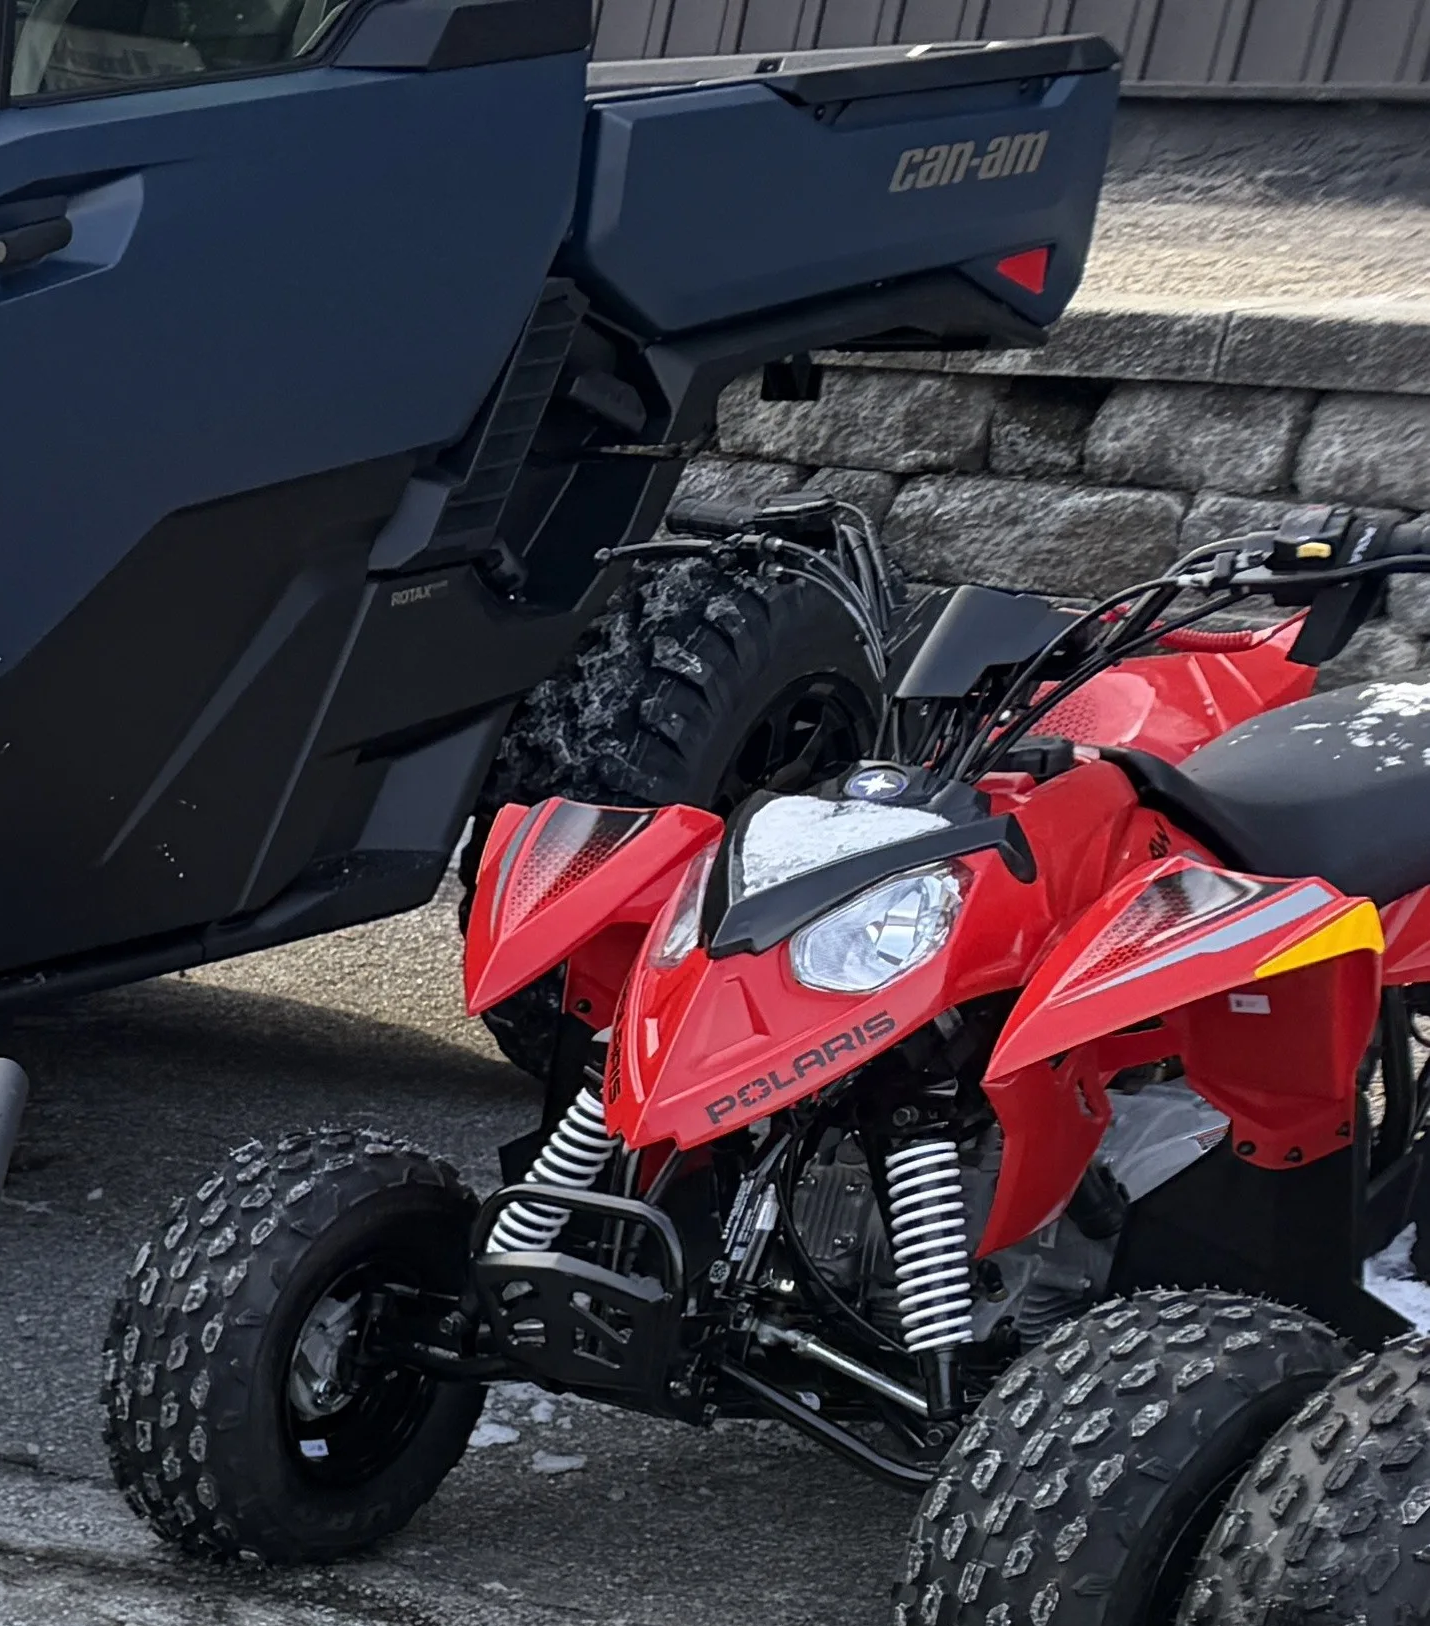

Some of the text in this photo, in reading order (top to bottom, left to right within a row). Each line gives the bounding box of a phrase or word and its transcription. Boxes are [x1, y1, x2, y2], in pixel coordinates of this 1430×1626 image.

[888, 129, 1051, 193] can-am
[391, 585, 433, 607] ROTAX
[704, 1009, 897, 1125] POLARIS
